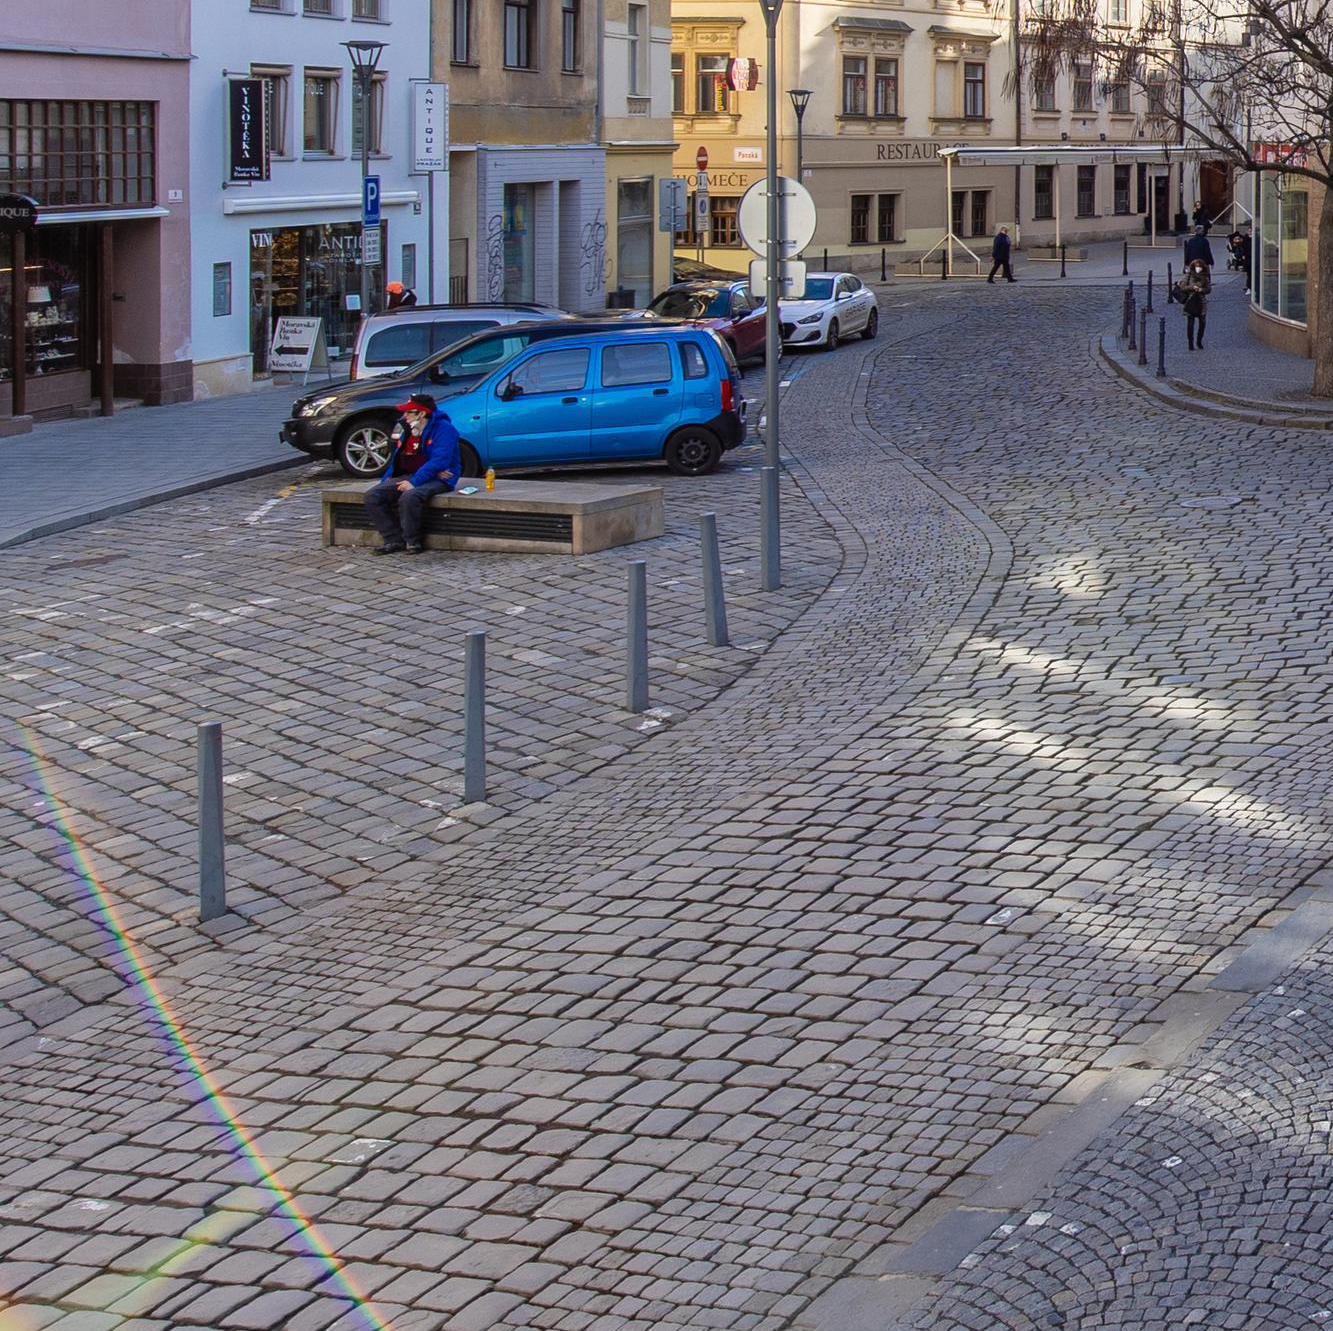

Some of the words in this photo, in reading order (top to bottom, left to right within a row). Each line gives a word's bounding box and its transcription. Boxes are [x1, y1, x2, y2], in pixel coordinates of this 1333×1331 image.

[425, 88, 434, 154] ANTIQUE
[707, 172, 748, 187] MEČE
[367, 182, 378, 211] P
